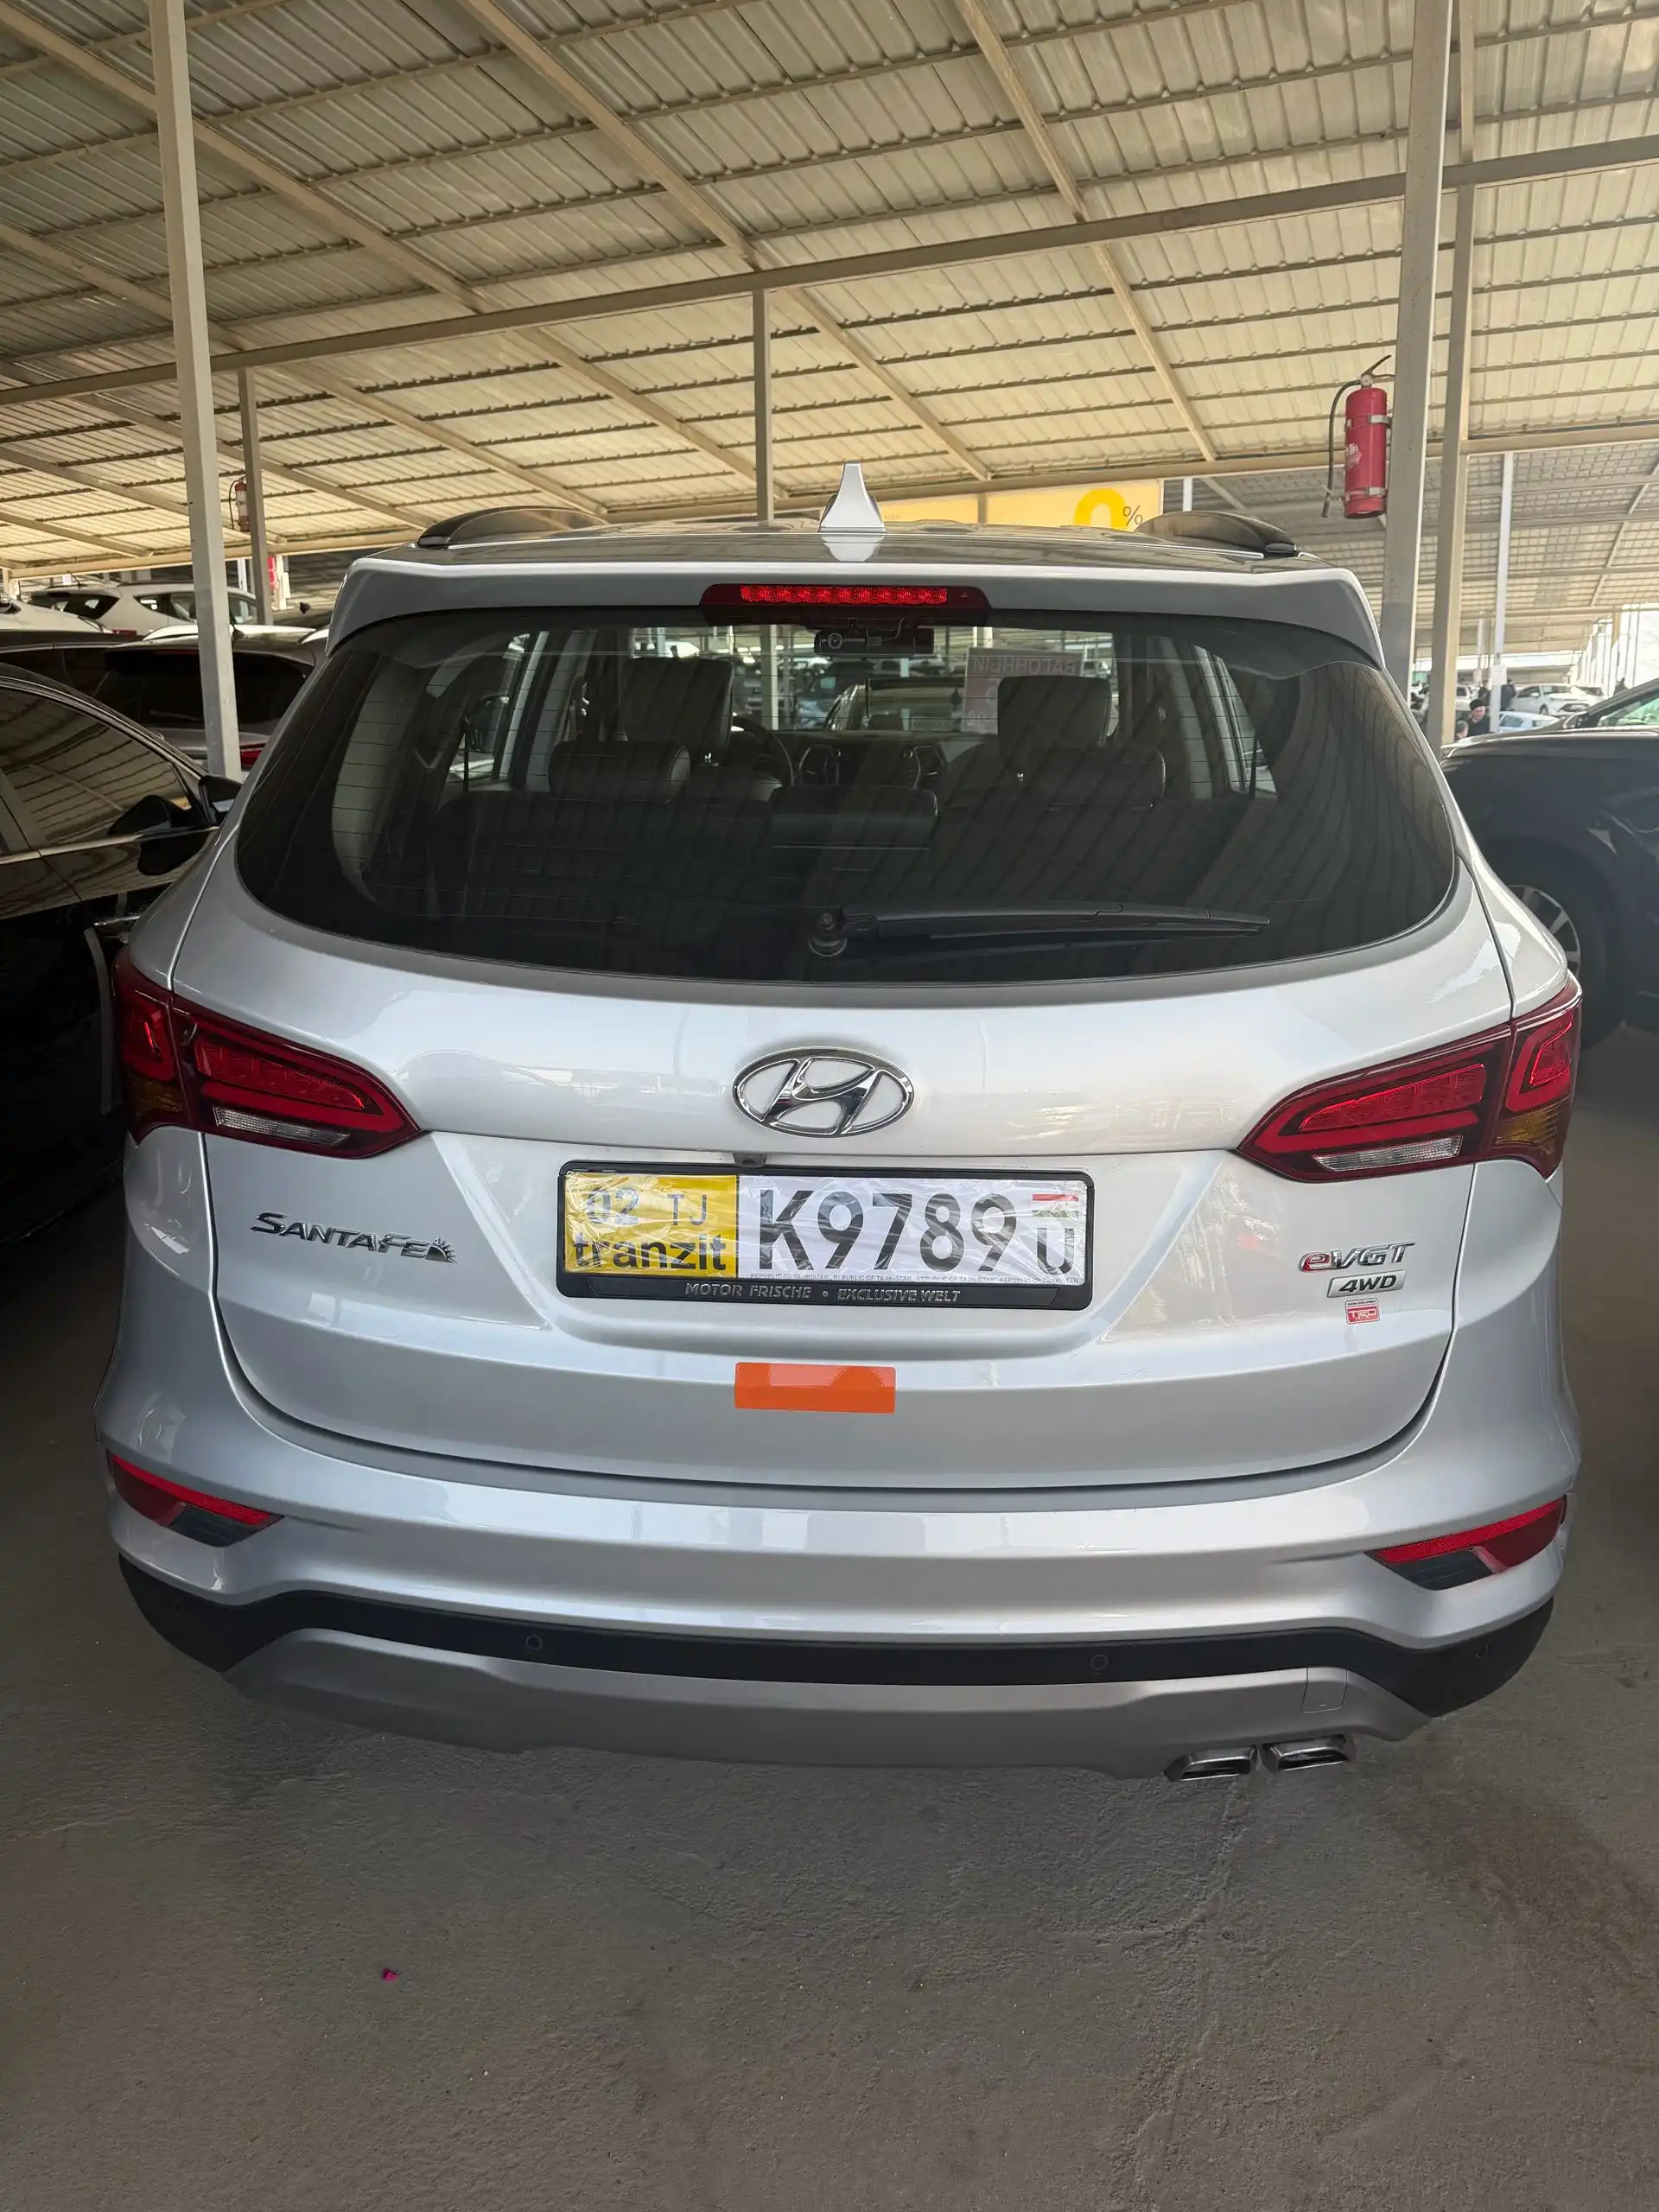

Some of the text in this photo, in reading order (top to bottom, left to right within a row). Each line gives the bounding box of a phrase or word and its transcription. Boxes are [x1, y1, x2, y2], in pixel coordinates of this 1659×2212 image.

[667, 1194, 708, 1226] TJ
[759, 1189, 1017, 1273] K9789
[574, 1232, 727, 1271] tranzit
[1037, 1227, 1075, 1275] U
[685, 1282, 961, 1303] MOTOR FRISCHE EXCLUSIVE WELT
[1338, 1274, 1397, 1293] 4WD
